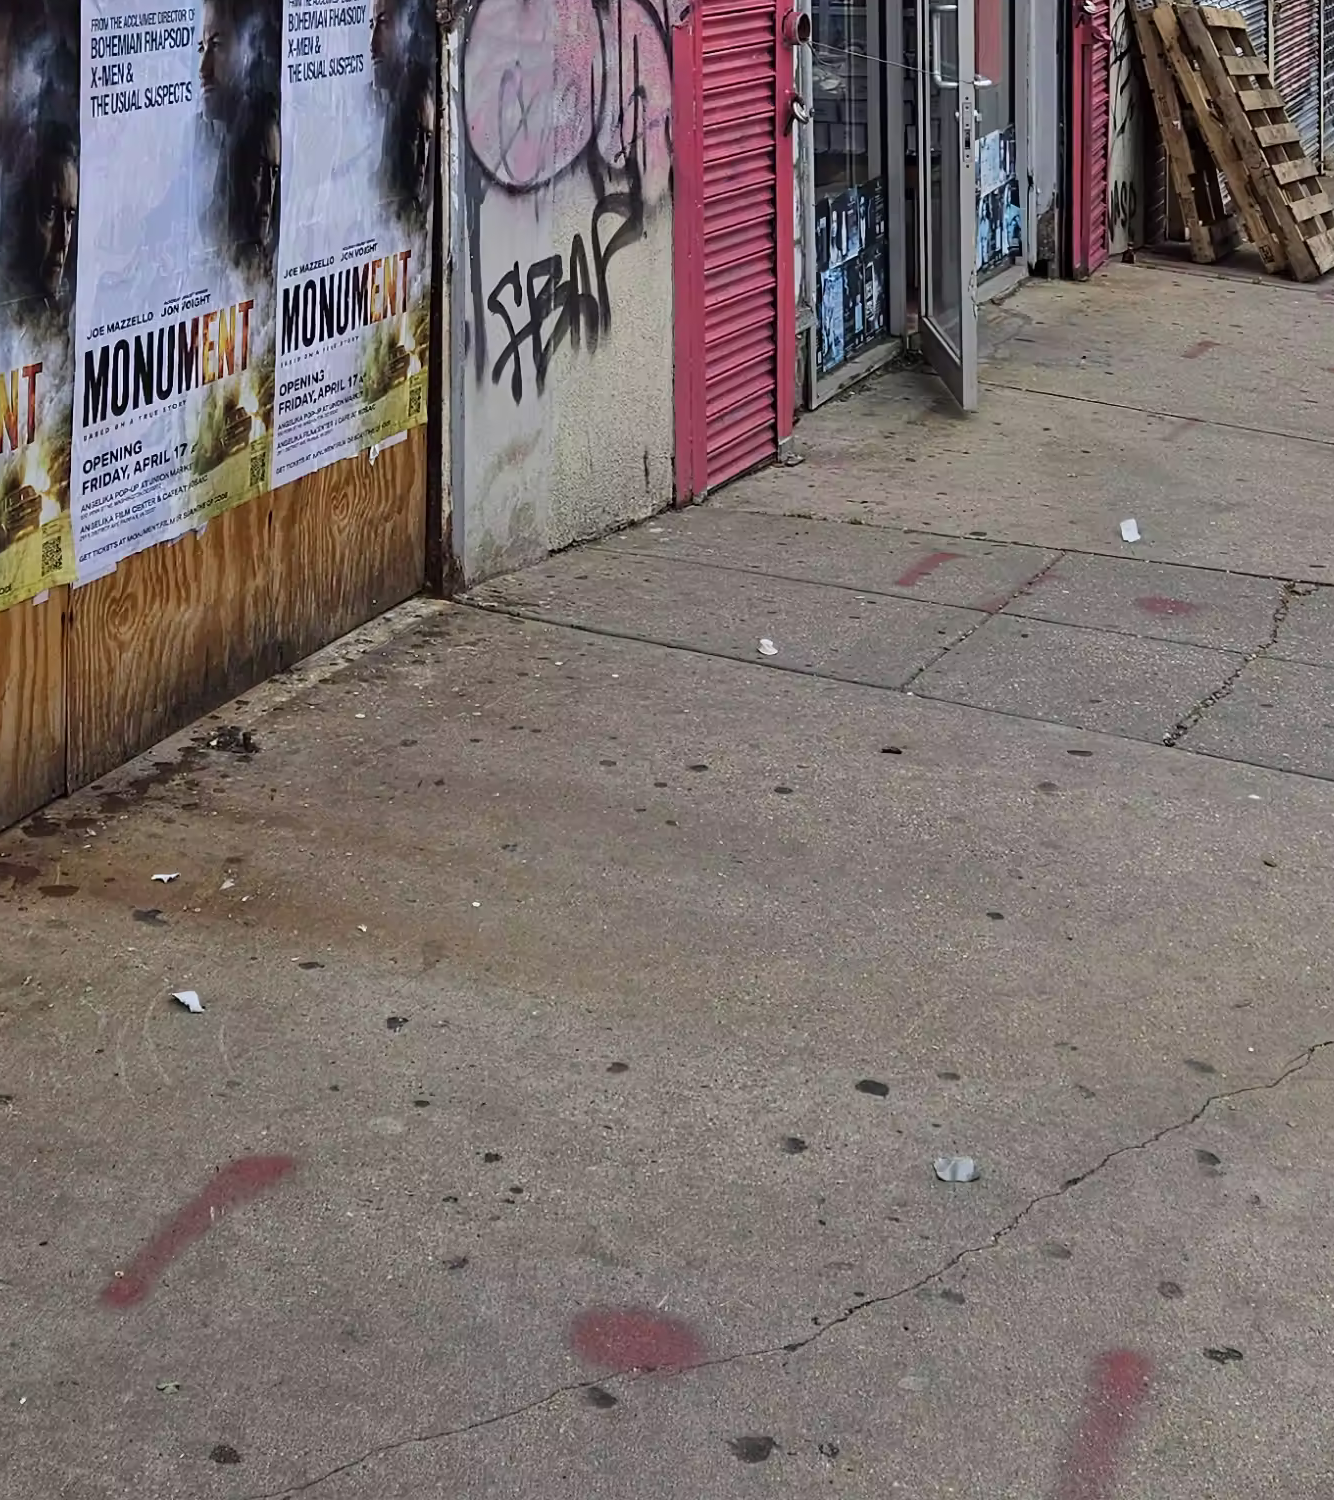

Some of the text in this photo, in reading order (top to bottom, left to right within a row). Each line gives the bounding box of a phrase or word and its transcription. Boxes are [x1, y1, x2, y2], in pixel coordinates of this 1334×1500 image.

[279, 247, 411, 356] MONUMENT
[82, 297, 254, 429] MONUMENT
[82, 438, 141, 476] OPENING
